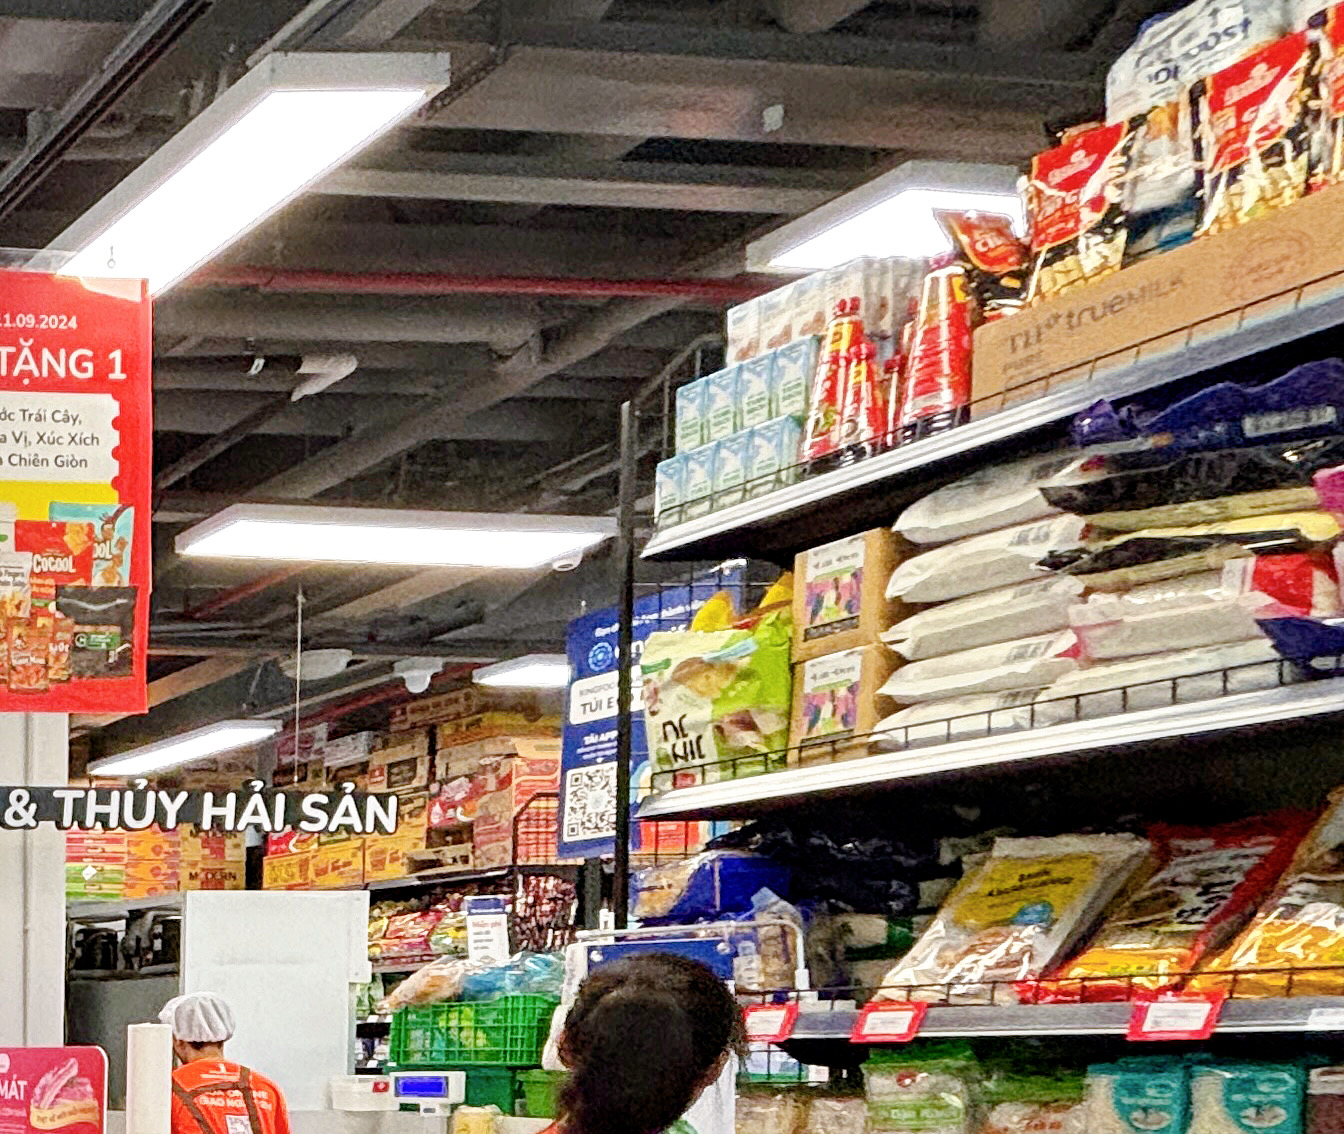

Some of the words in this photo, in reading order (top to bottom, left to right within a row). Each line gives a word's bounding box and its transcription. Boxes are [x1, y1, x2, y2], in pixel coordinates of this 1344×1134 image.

[108, 349, 127, 380] 1
[19, 408, 46, 422] Trái
[51, 410, 83, 426] Cây,
[11, 430, 32, 448] Vị,
[36, 431, 64, 446] Xúc
[67, 431, 100, 446] Xích
[7, 454, 49, 467] Chiên
[54, 455, 88, 468] Giòn
[4, 789, 38, 828] &
[51, 779, 194, 830] THỦY
[202, 780, 286, 833] HẢI
[299, 781, 398, 834] SẢN
